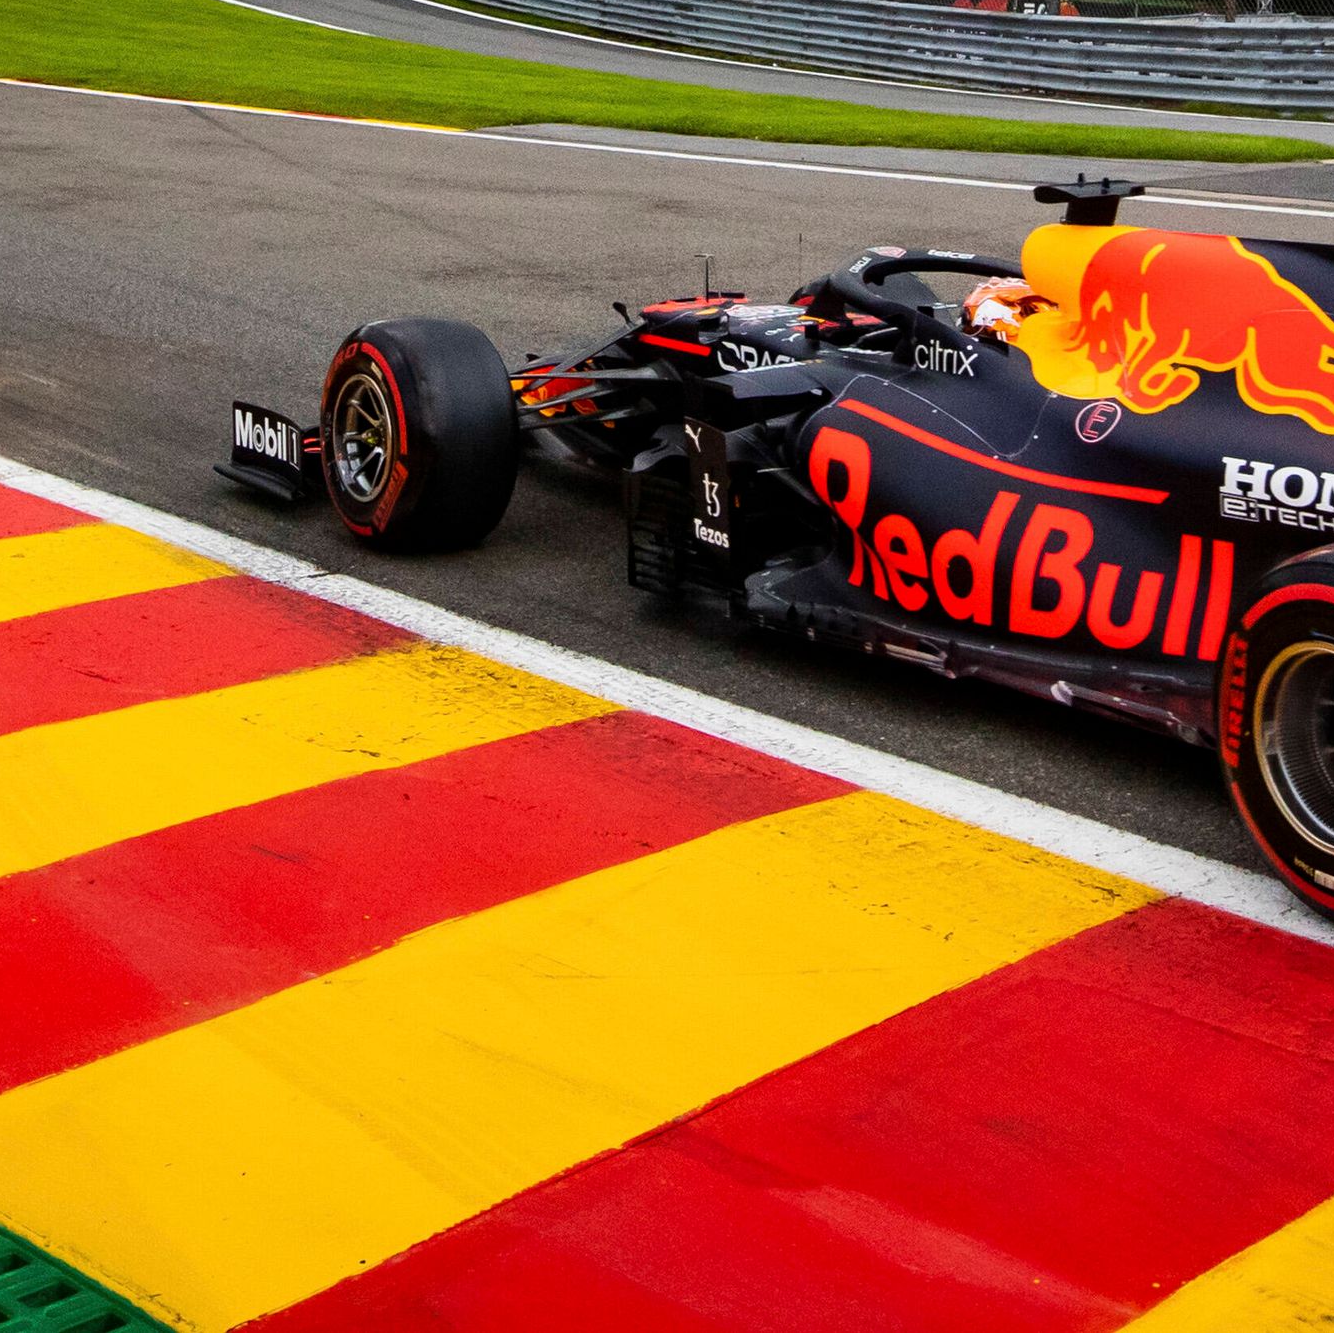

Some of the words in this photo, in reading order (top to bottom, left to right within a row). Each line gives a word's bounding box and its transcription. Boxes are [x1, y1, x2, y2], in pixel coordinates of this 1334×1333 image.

[915, 339, 979, 377] citrix
[234, 408, 287, 463] Mobil
[693, 517, 730, 549] Tezos
